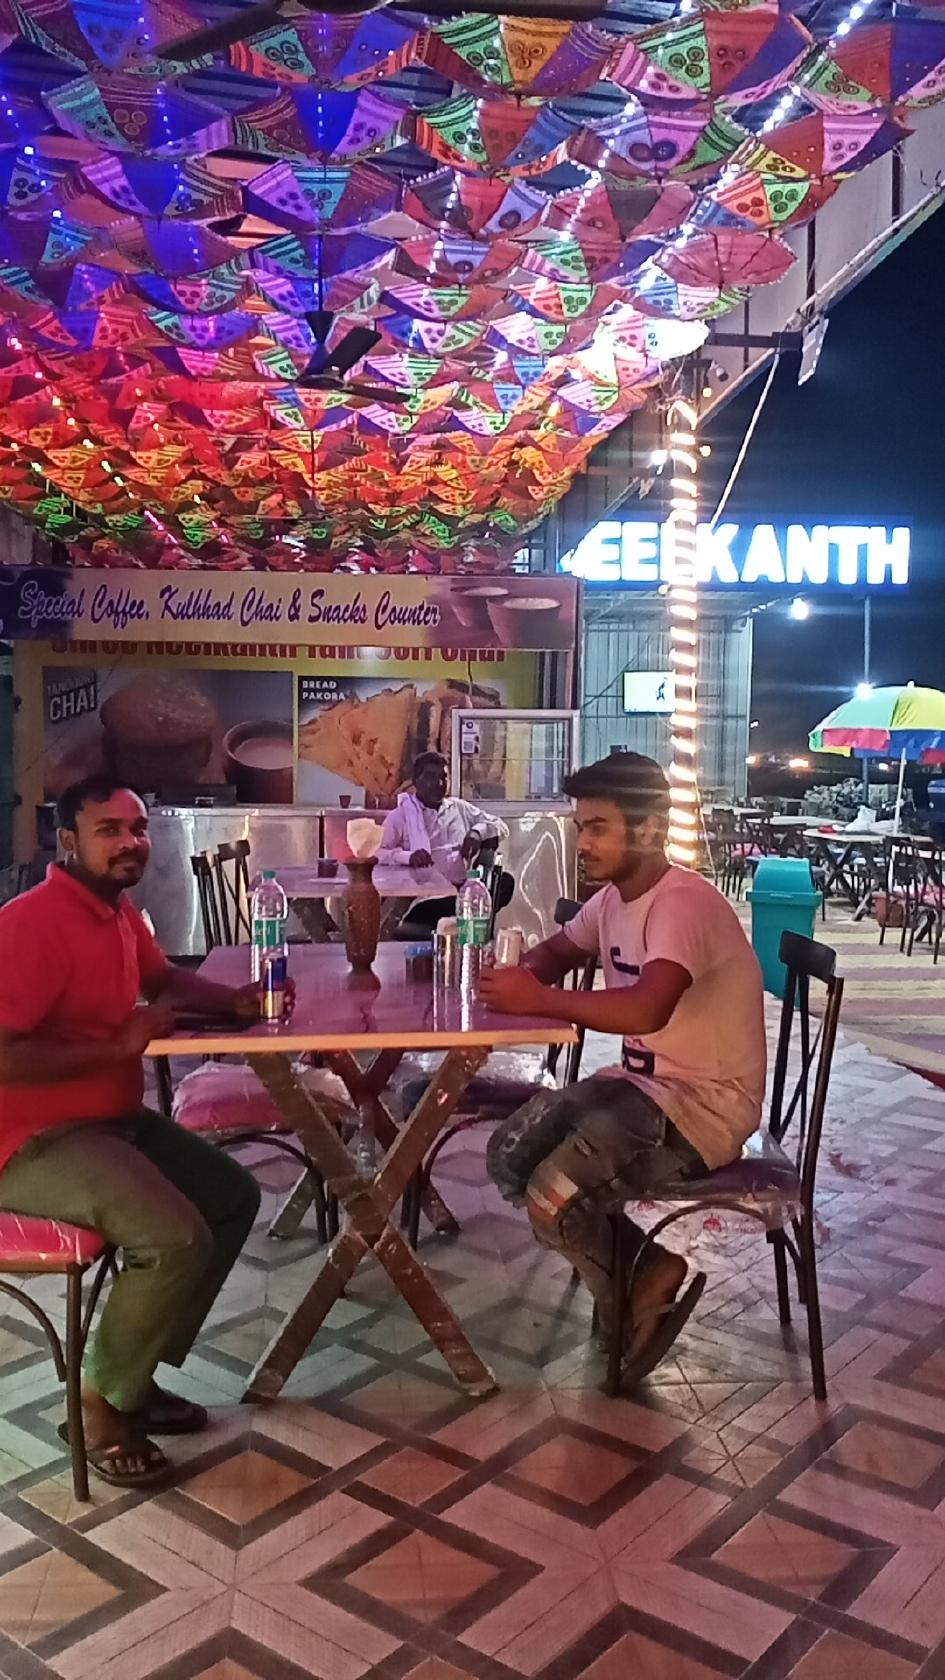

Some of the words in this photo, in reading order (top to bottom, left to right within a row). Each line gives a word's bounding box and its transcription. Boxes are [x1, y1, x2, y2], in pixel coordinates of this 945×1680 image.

[18, 580, 84, 628] Special
[159, 584, 235, 621] Kulhhad
[240, 586, 282, 627] Chai
[287, 587, 301, 622] &
[308, 588, 367, 624] Snacks
[374, 590, 440, 630] Counter
[302, 680, 337, 690] BREAD
[302, 691, 346, 701] PAKORA
[50, 685, 96, 721] CHAI
